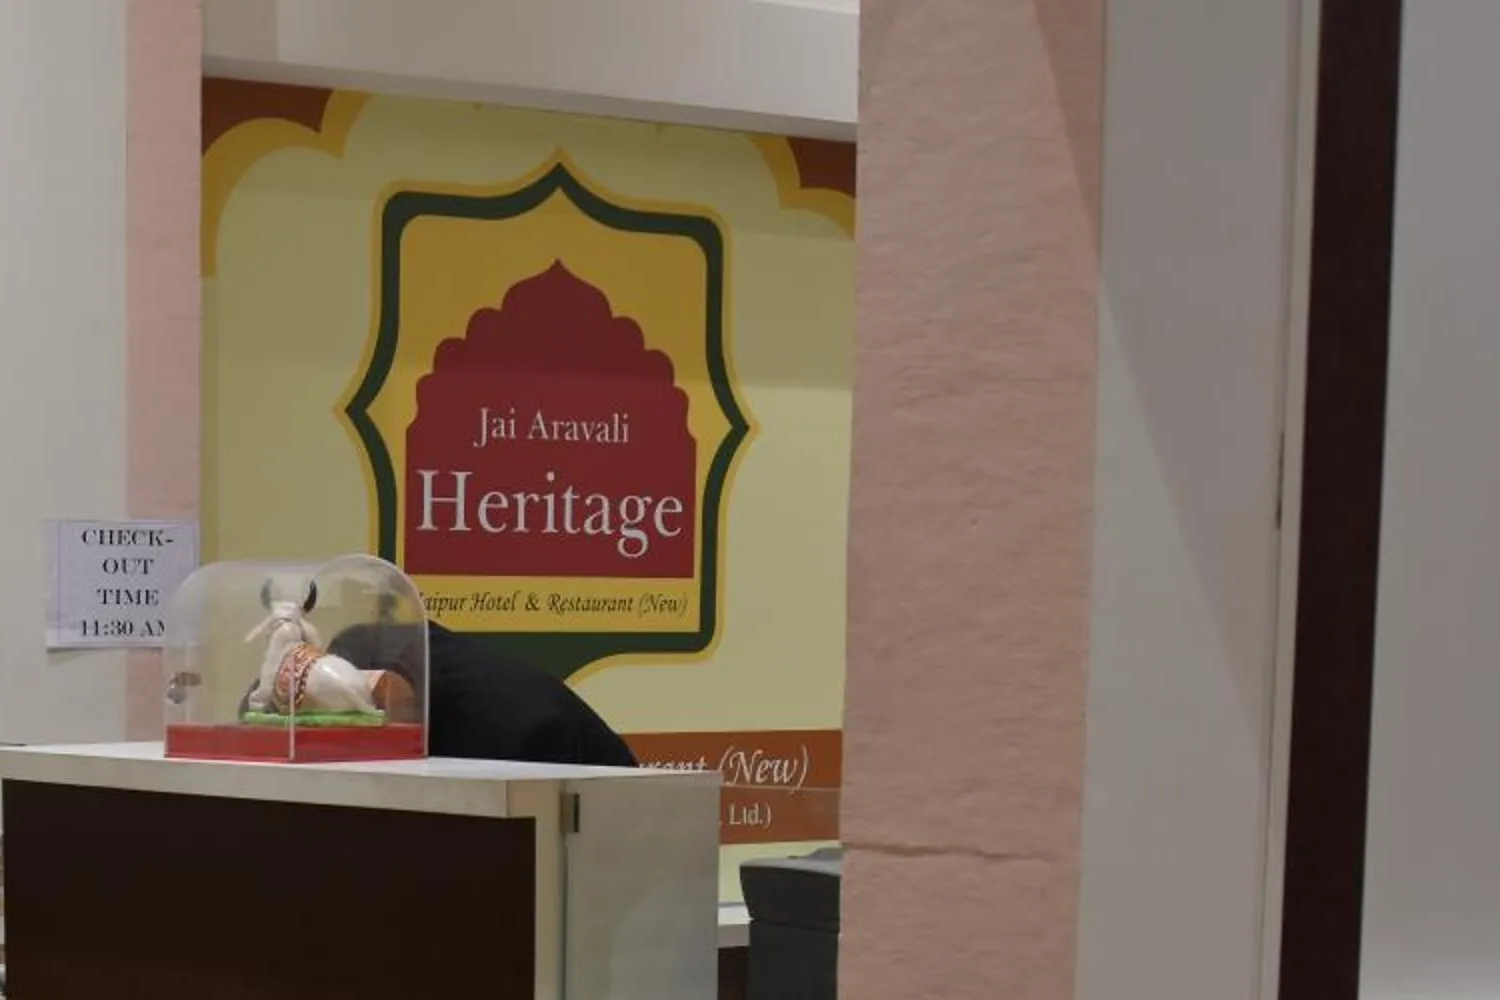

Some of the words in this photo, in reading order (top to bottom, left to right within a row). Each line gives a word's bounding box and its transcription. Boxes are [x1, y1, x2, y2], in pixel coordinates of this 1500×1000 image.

[473, 407, 516, 447] Jai
[527, 410, 629, 443] Aravali
[416, 469, 683, 558] Heritage
[81, 529, 174, 547] CHECK-
[102, 558, 154, 574] OUT
[97, 589, 159, 605] TIME
[419, 591, 466, 617] aipur
[468, 590, 520, 612] Hotel
[524, 597, 541, 612] &
[547, 593, 634, 613] Restaurant
[637, 592, 689, 617] (New)
[82, 620, 134, 636] 11:30
[728, 803, 773, 829] Ltd.)
